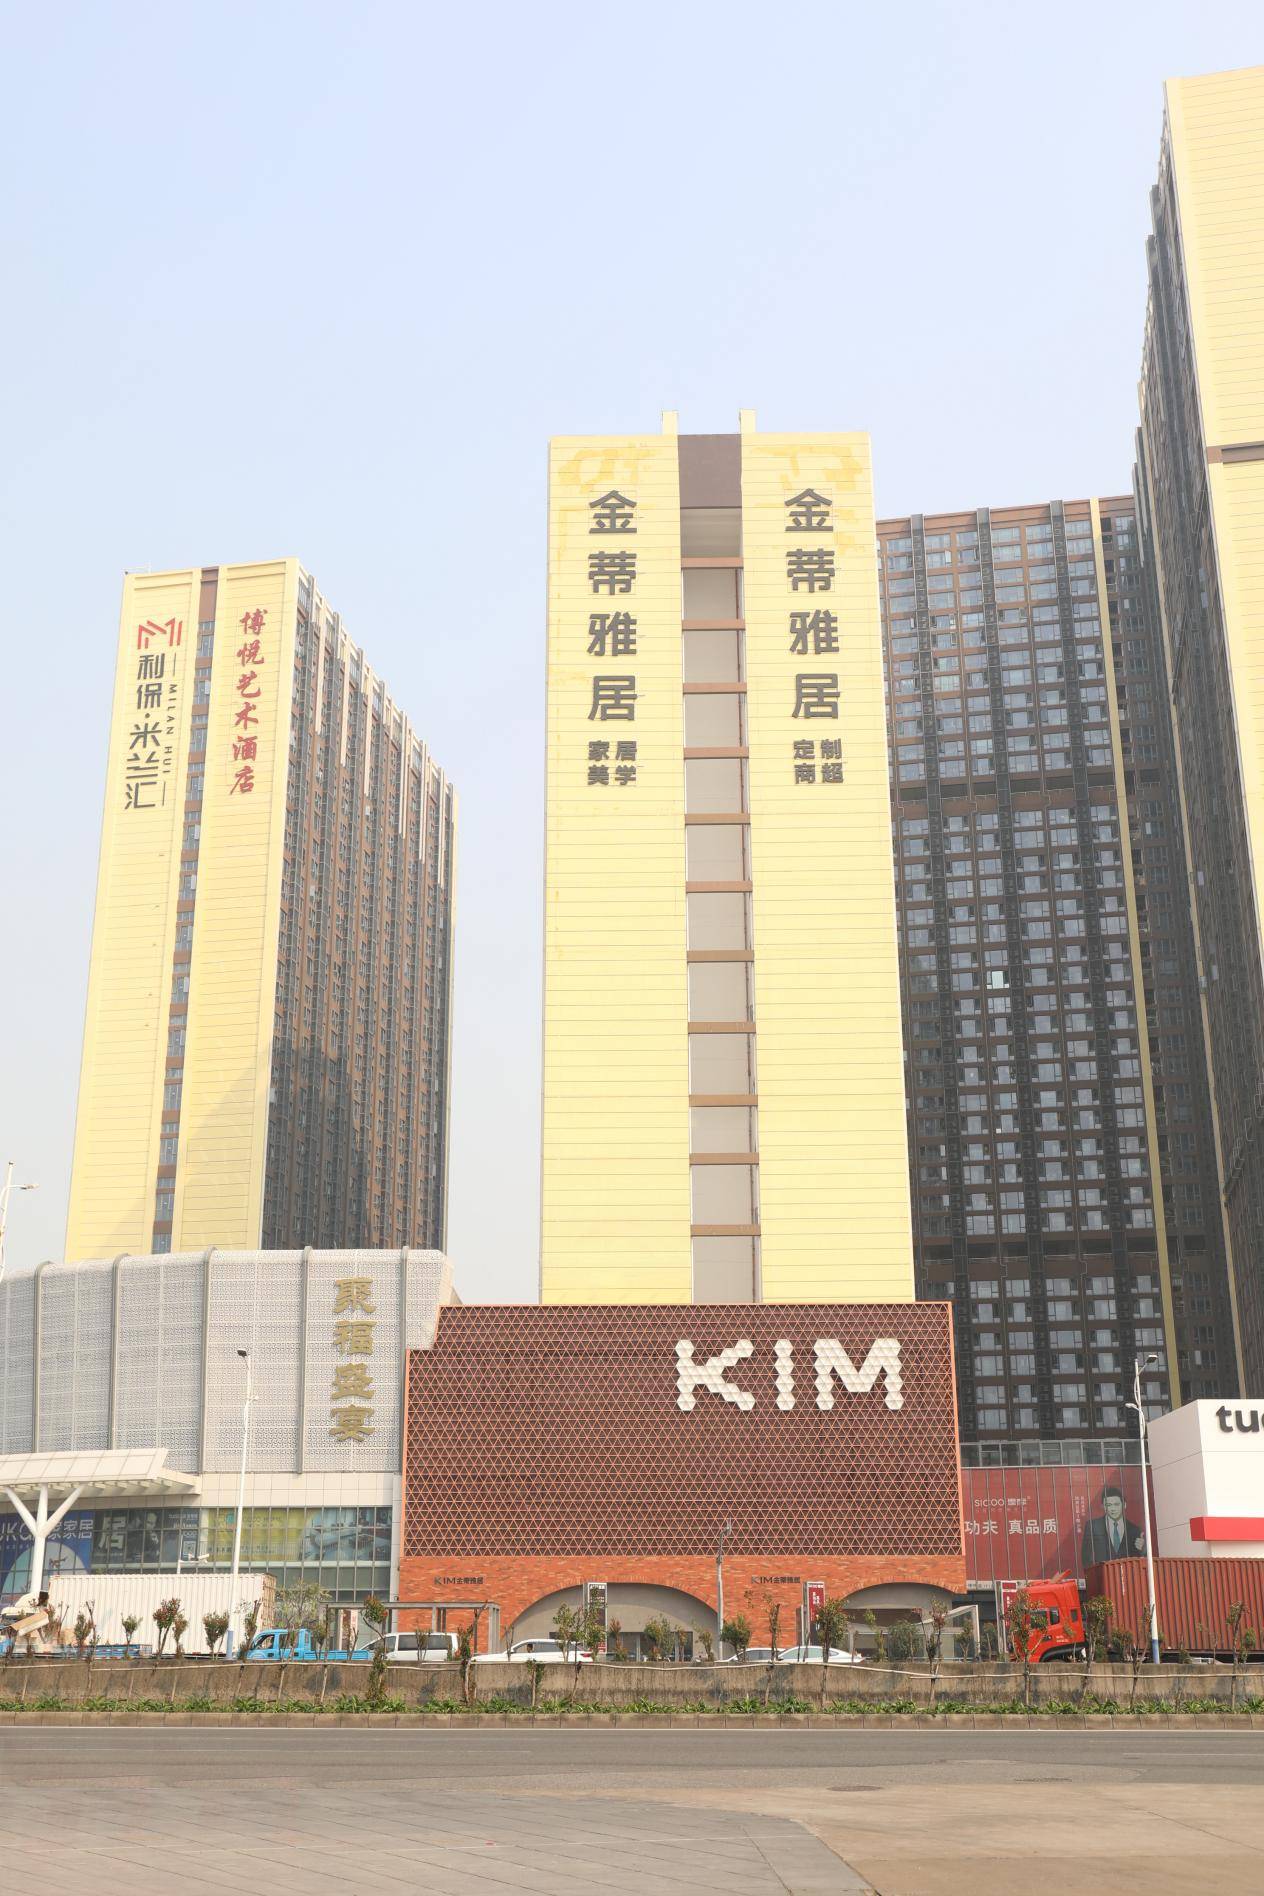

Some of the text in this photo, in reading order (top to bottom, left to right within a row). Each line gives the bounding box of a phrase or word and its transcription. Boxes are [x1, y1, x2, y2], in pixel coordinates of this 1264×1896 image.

[587, 489, 638, 721] 金蒂雅居
[784, 487, 841, 720] 金蒂雅居
[229, 608, 269, 796] 博悦艺术酒店
[163, 683, 178, 774] MILAN HUI
[588, 739, 638, 762] 家居
[793, 738, 843, 760] 定制
[587, 765, 637, 786] 美学
[794, 762, 844, 785] 商超
[329, 1276, 377, 1443] 聚福盛宴
[674, 1338, 905, 1411] KIM
[1215, 1405, 1264, 1433] tu
[1008, 1518, 1057, 1535] 真品质
